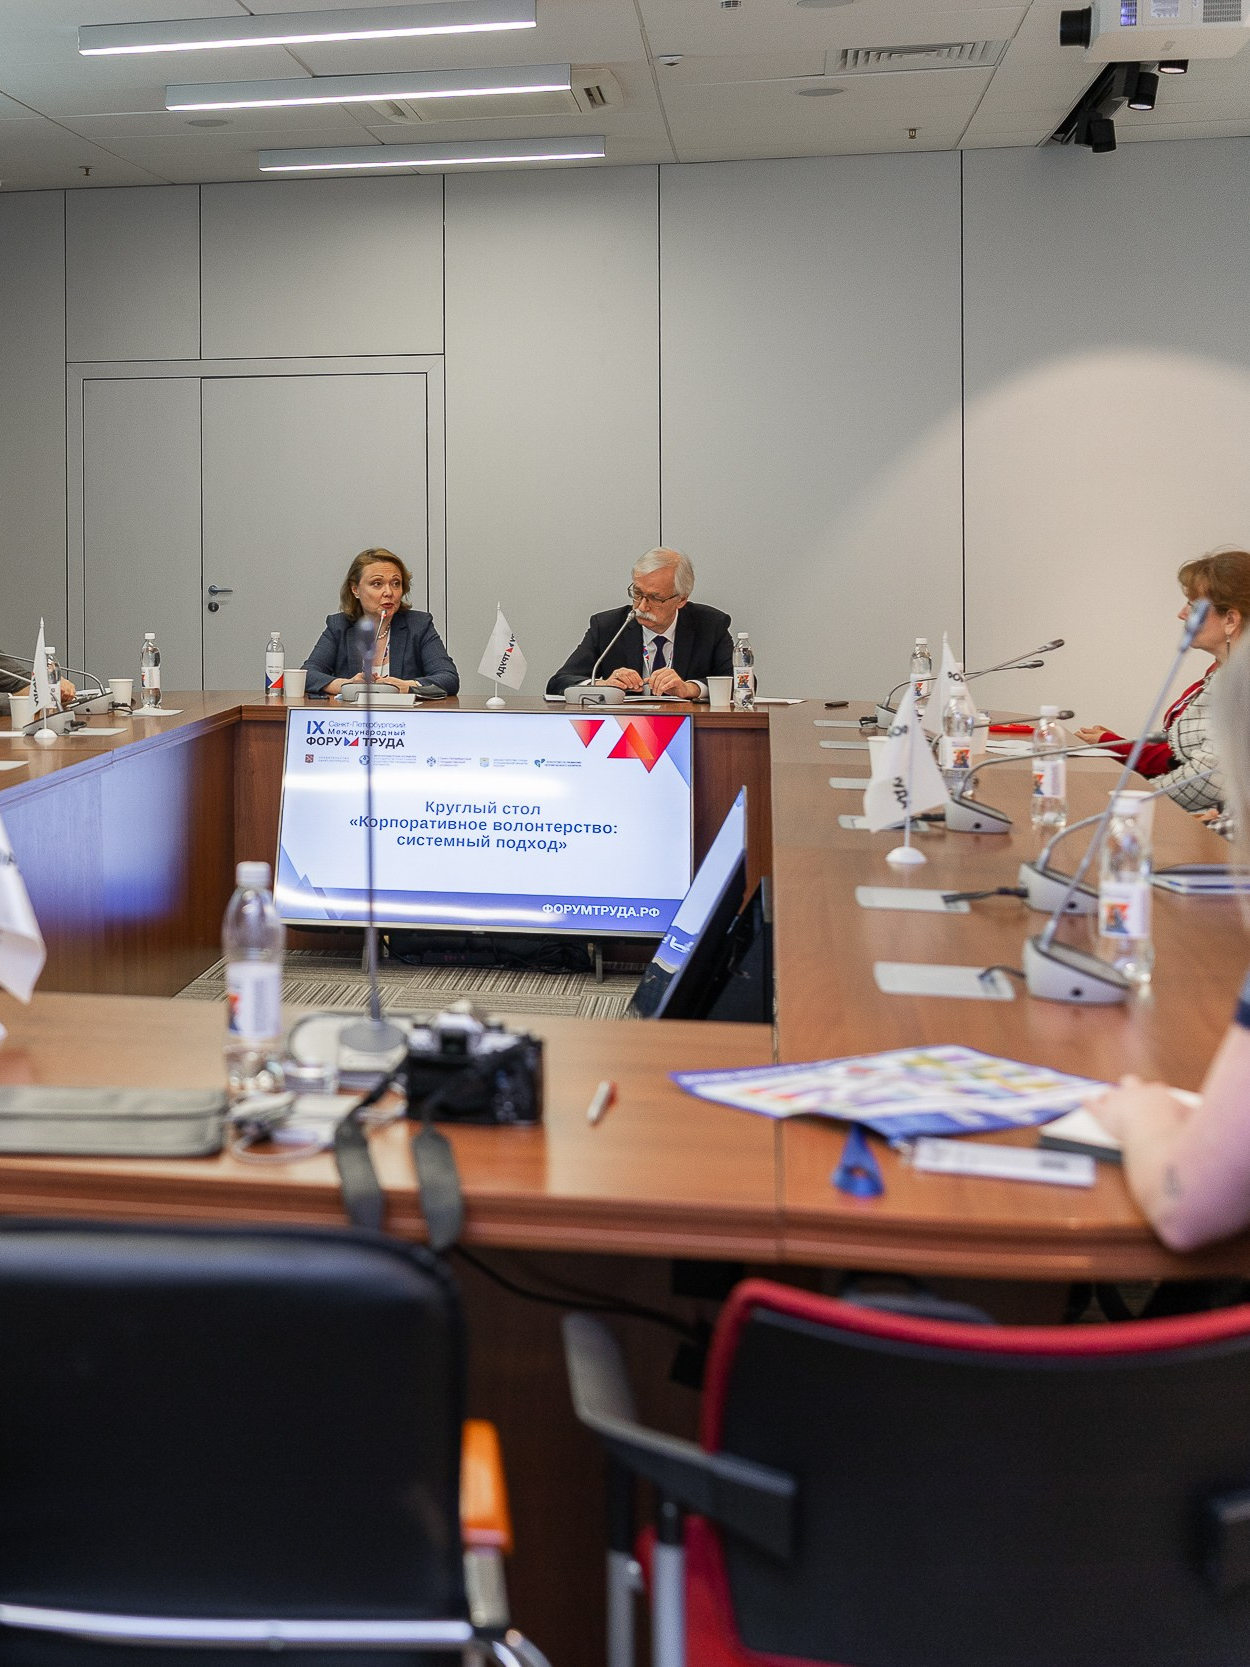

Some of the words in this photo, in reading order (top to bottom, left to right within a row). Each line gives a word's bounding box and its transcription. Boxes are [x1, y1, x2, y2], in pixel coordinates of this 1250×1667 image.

[306, 720, 326, 735] IX
[327, 728, 406, 736] Международный
[328, 720, 406, 730] Санкт-Петербургский
[362, 737, 405, 749] ТРУДА
[425, 800, 497, 815] Круглый
[502, 803, 541, 815] стол
[349, 816, 488, 832] «Корпоративное
[493, 821, 618, 836] волонтерство:
[397, 832, 490, 848] системный
[496, 838, 567, 852] подход»
[542, 903, 660, 918] ФОРУМТРУДА.РФ
